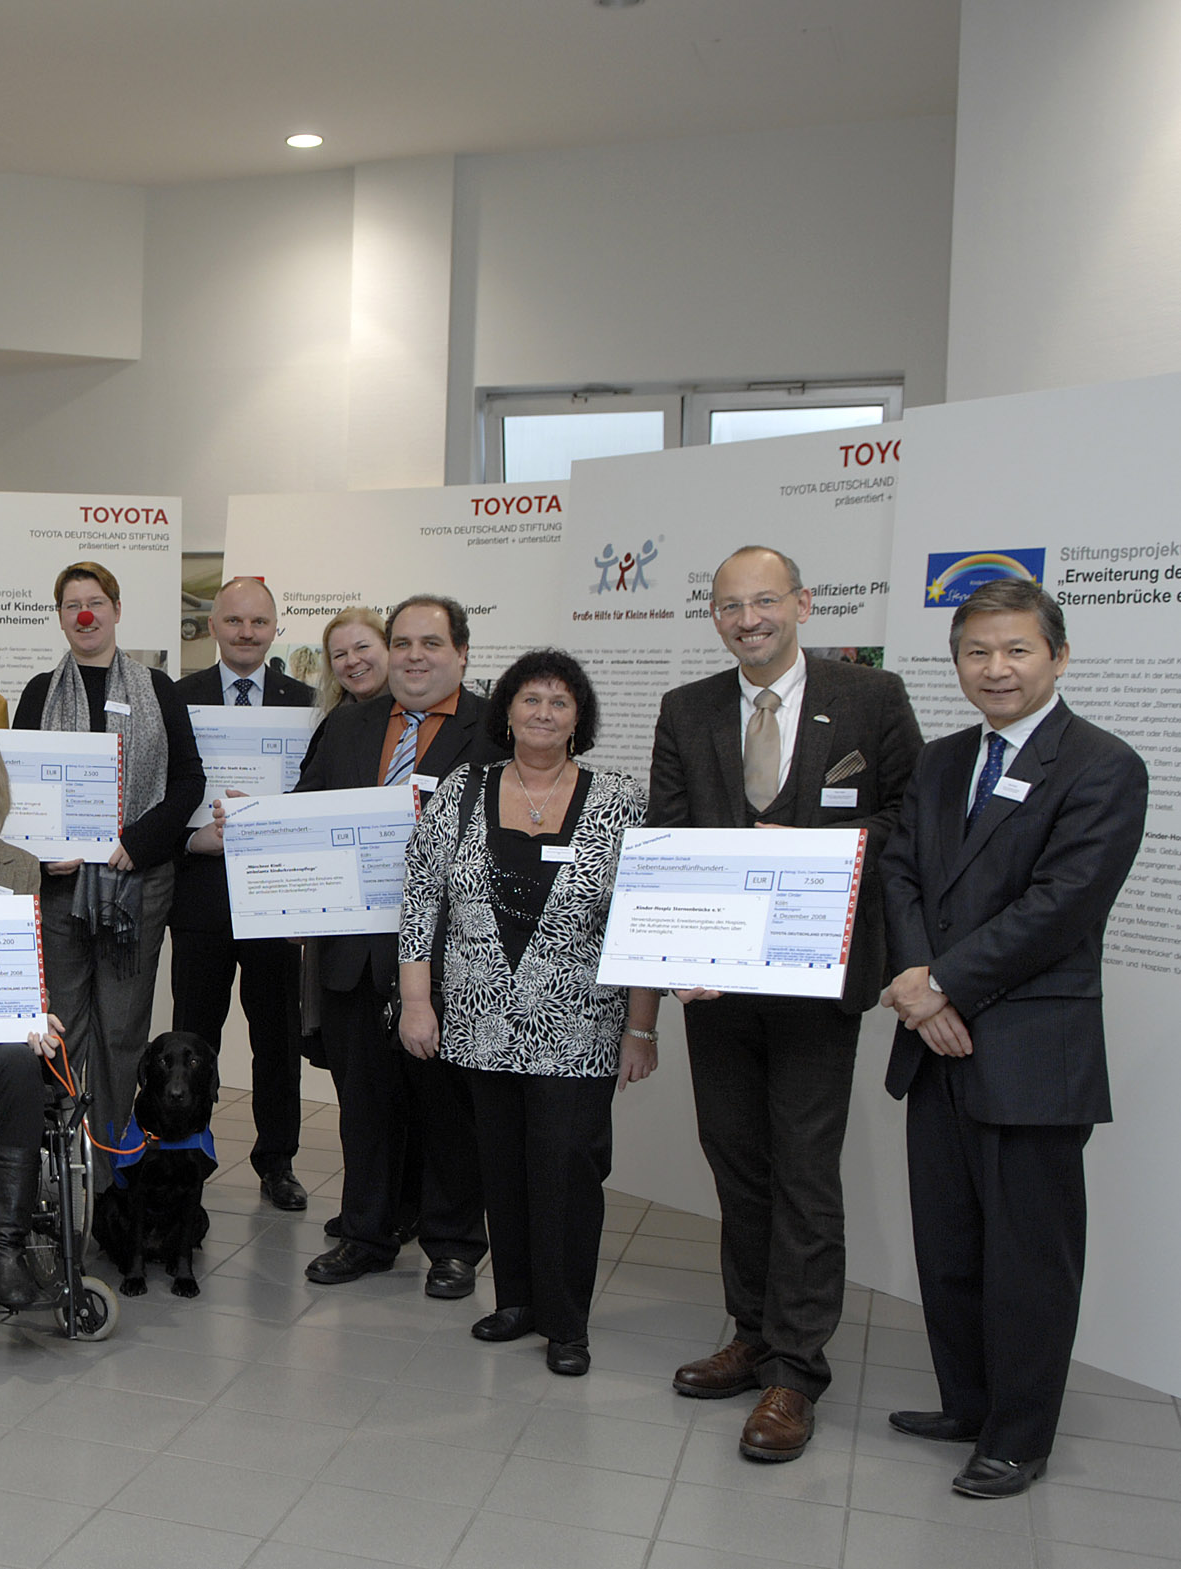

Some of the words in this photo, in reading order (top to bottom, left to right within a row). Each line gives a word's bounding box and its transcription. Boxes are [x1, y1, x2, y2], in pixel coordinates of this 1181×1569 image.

[780, 484, 817, 496] TOYOTA
[819, 476, 895, 494] DEUTSCHLAND
[471, 495, 562, 516] TOYOTA
[835, 493, 884, 508] präsentiert
[79, 506, 169, 525] TOYOTA
[29, 529, 63, 539] TOYOTA
[64, 530, 127, 541] DEUTSCHLAND
[128, 532, 169, 542] STIFTUNG
[420, 526, 452, 536] TOYOTA
[454, 524, 517, 535] DEUTSCHLAND
[519, 522, 563, 533] STIFTUNG
[78, 542, 119, 551] präsentiert
[128, 543, 169, 551] unterstützt
[467, 537, 509, 547] präsentiert
[518, 534, 561, 544] unterstützt
[282, 591, 362, 603] Stiftungsprojekt
[1057, 588, 1172, 606] Sternenbrücke
[572, 611, 593, 621] Große
[594, 611, 612, 621] Hilfe
[613, 610, 624, 620] für
[625, 609, 648, 620] Kleine
[649, 609, 675, 620] Helden
[637, 864, 724, 872] Siebentausendfünfhundert
